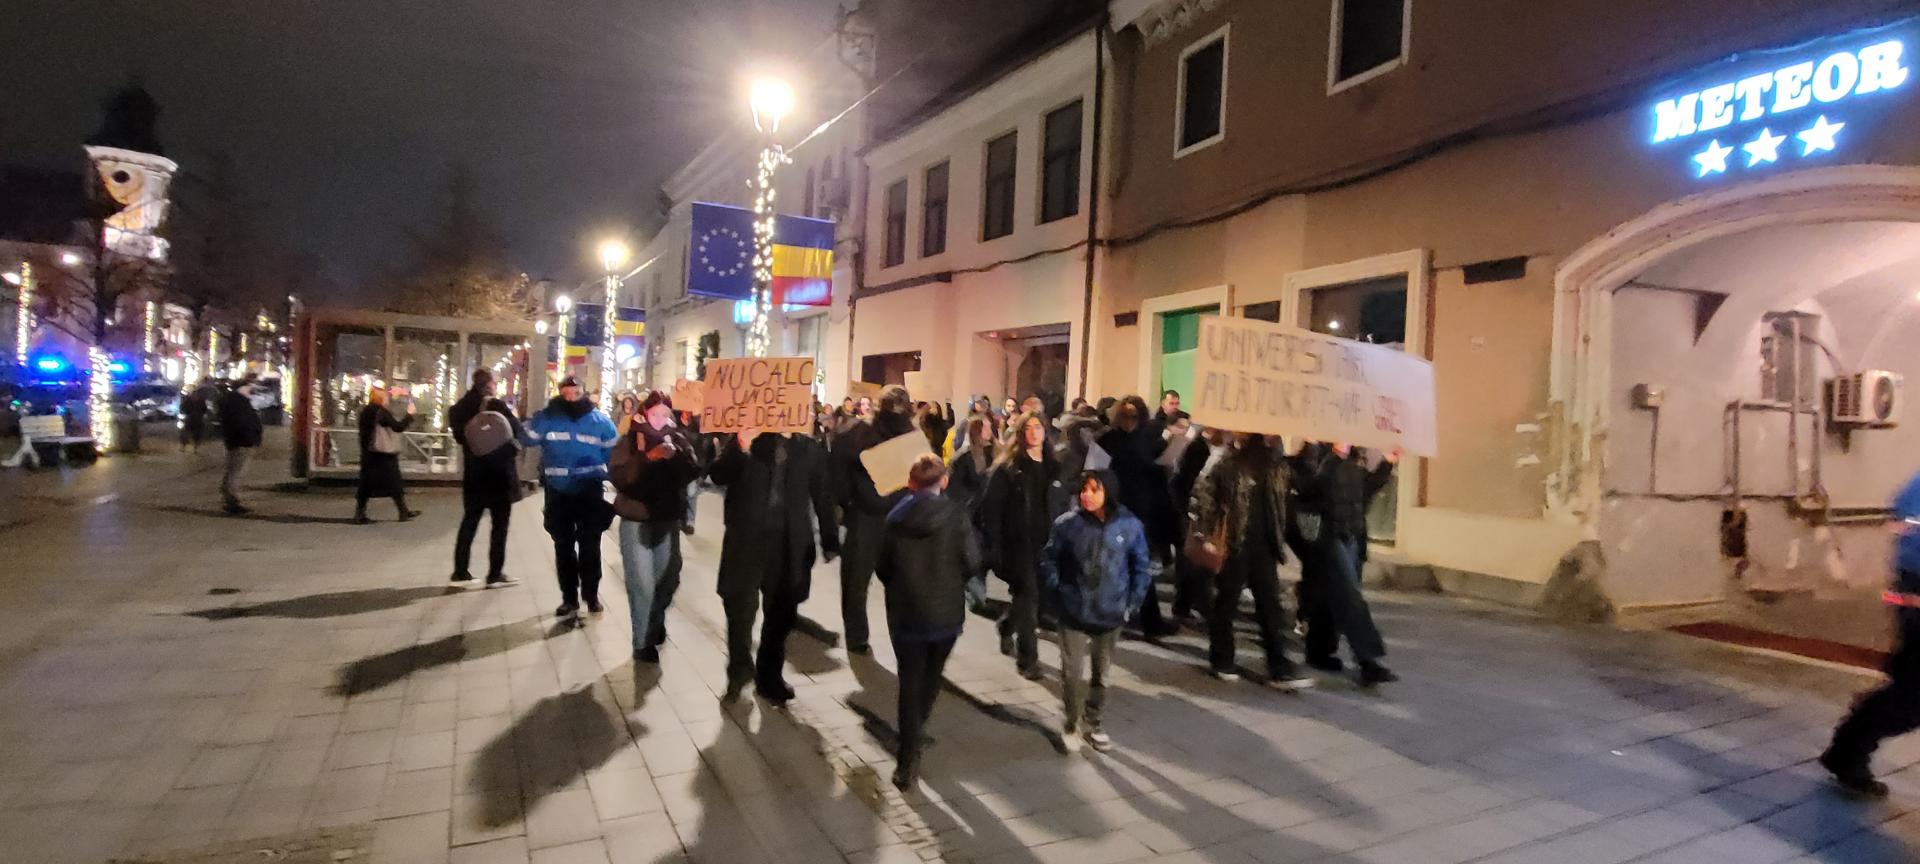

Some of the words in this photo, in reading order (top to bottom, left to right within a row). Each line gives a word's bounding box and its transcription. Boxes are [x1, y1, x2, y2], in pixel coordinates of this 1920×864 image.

[1653, 40, 1908, 143] METEOR
[733, 387, 786, 405] UNDE
[703, 406, 746, 427] FUGE
